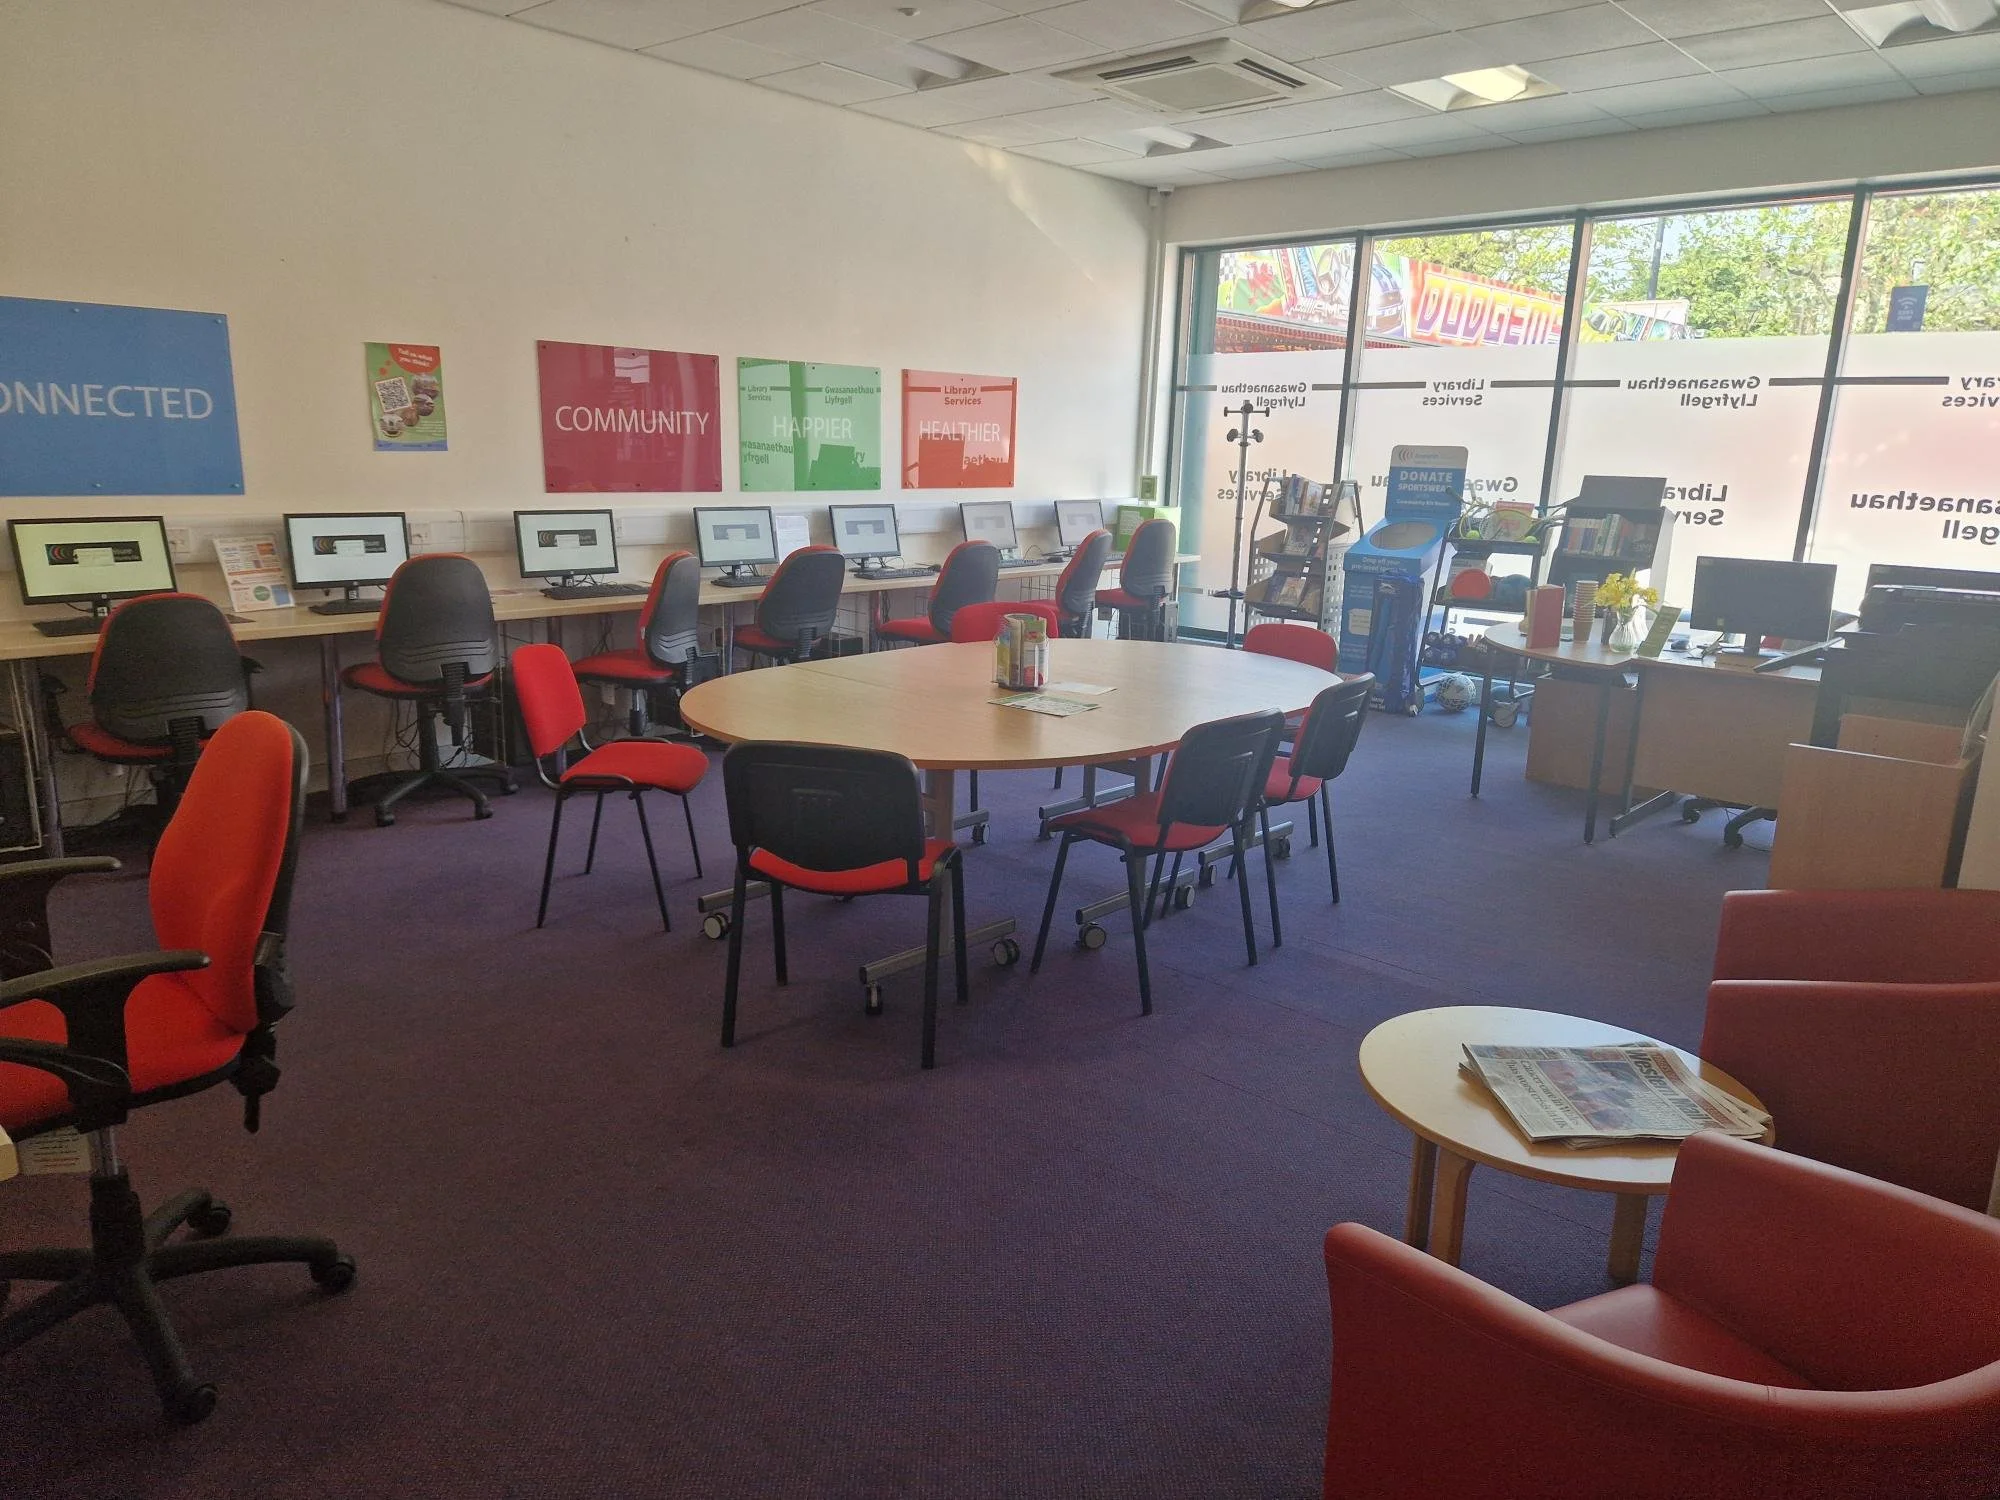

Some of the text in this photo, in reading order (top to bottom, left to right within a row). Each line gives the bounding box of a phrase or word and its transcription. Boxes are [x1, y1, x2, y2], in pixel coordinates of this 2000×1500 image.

[824, 385, 875, 394] Gwasanaethau
[944, 386, 977, 395] Library
[944, 397, 981, 405] Services
[555, 405, 709, 435] COMMUNITY
[772, 416, 852, 439] HAPPIER
[919, 420, 1001, 442] HEALTHIER
[1400, 470, 1453, 482] DONATE
[1397, 483, 1453, 493] SPORTSWEA
[1623, 1049, 1684, 1095] Western
